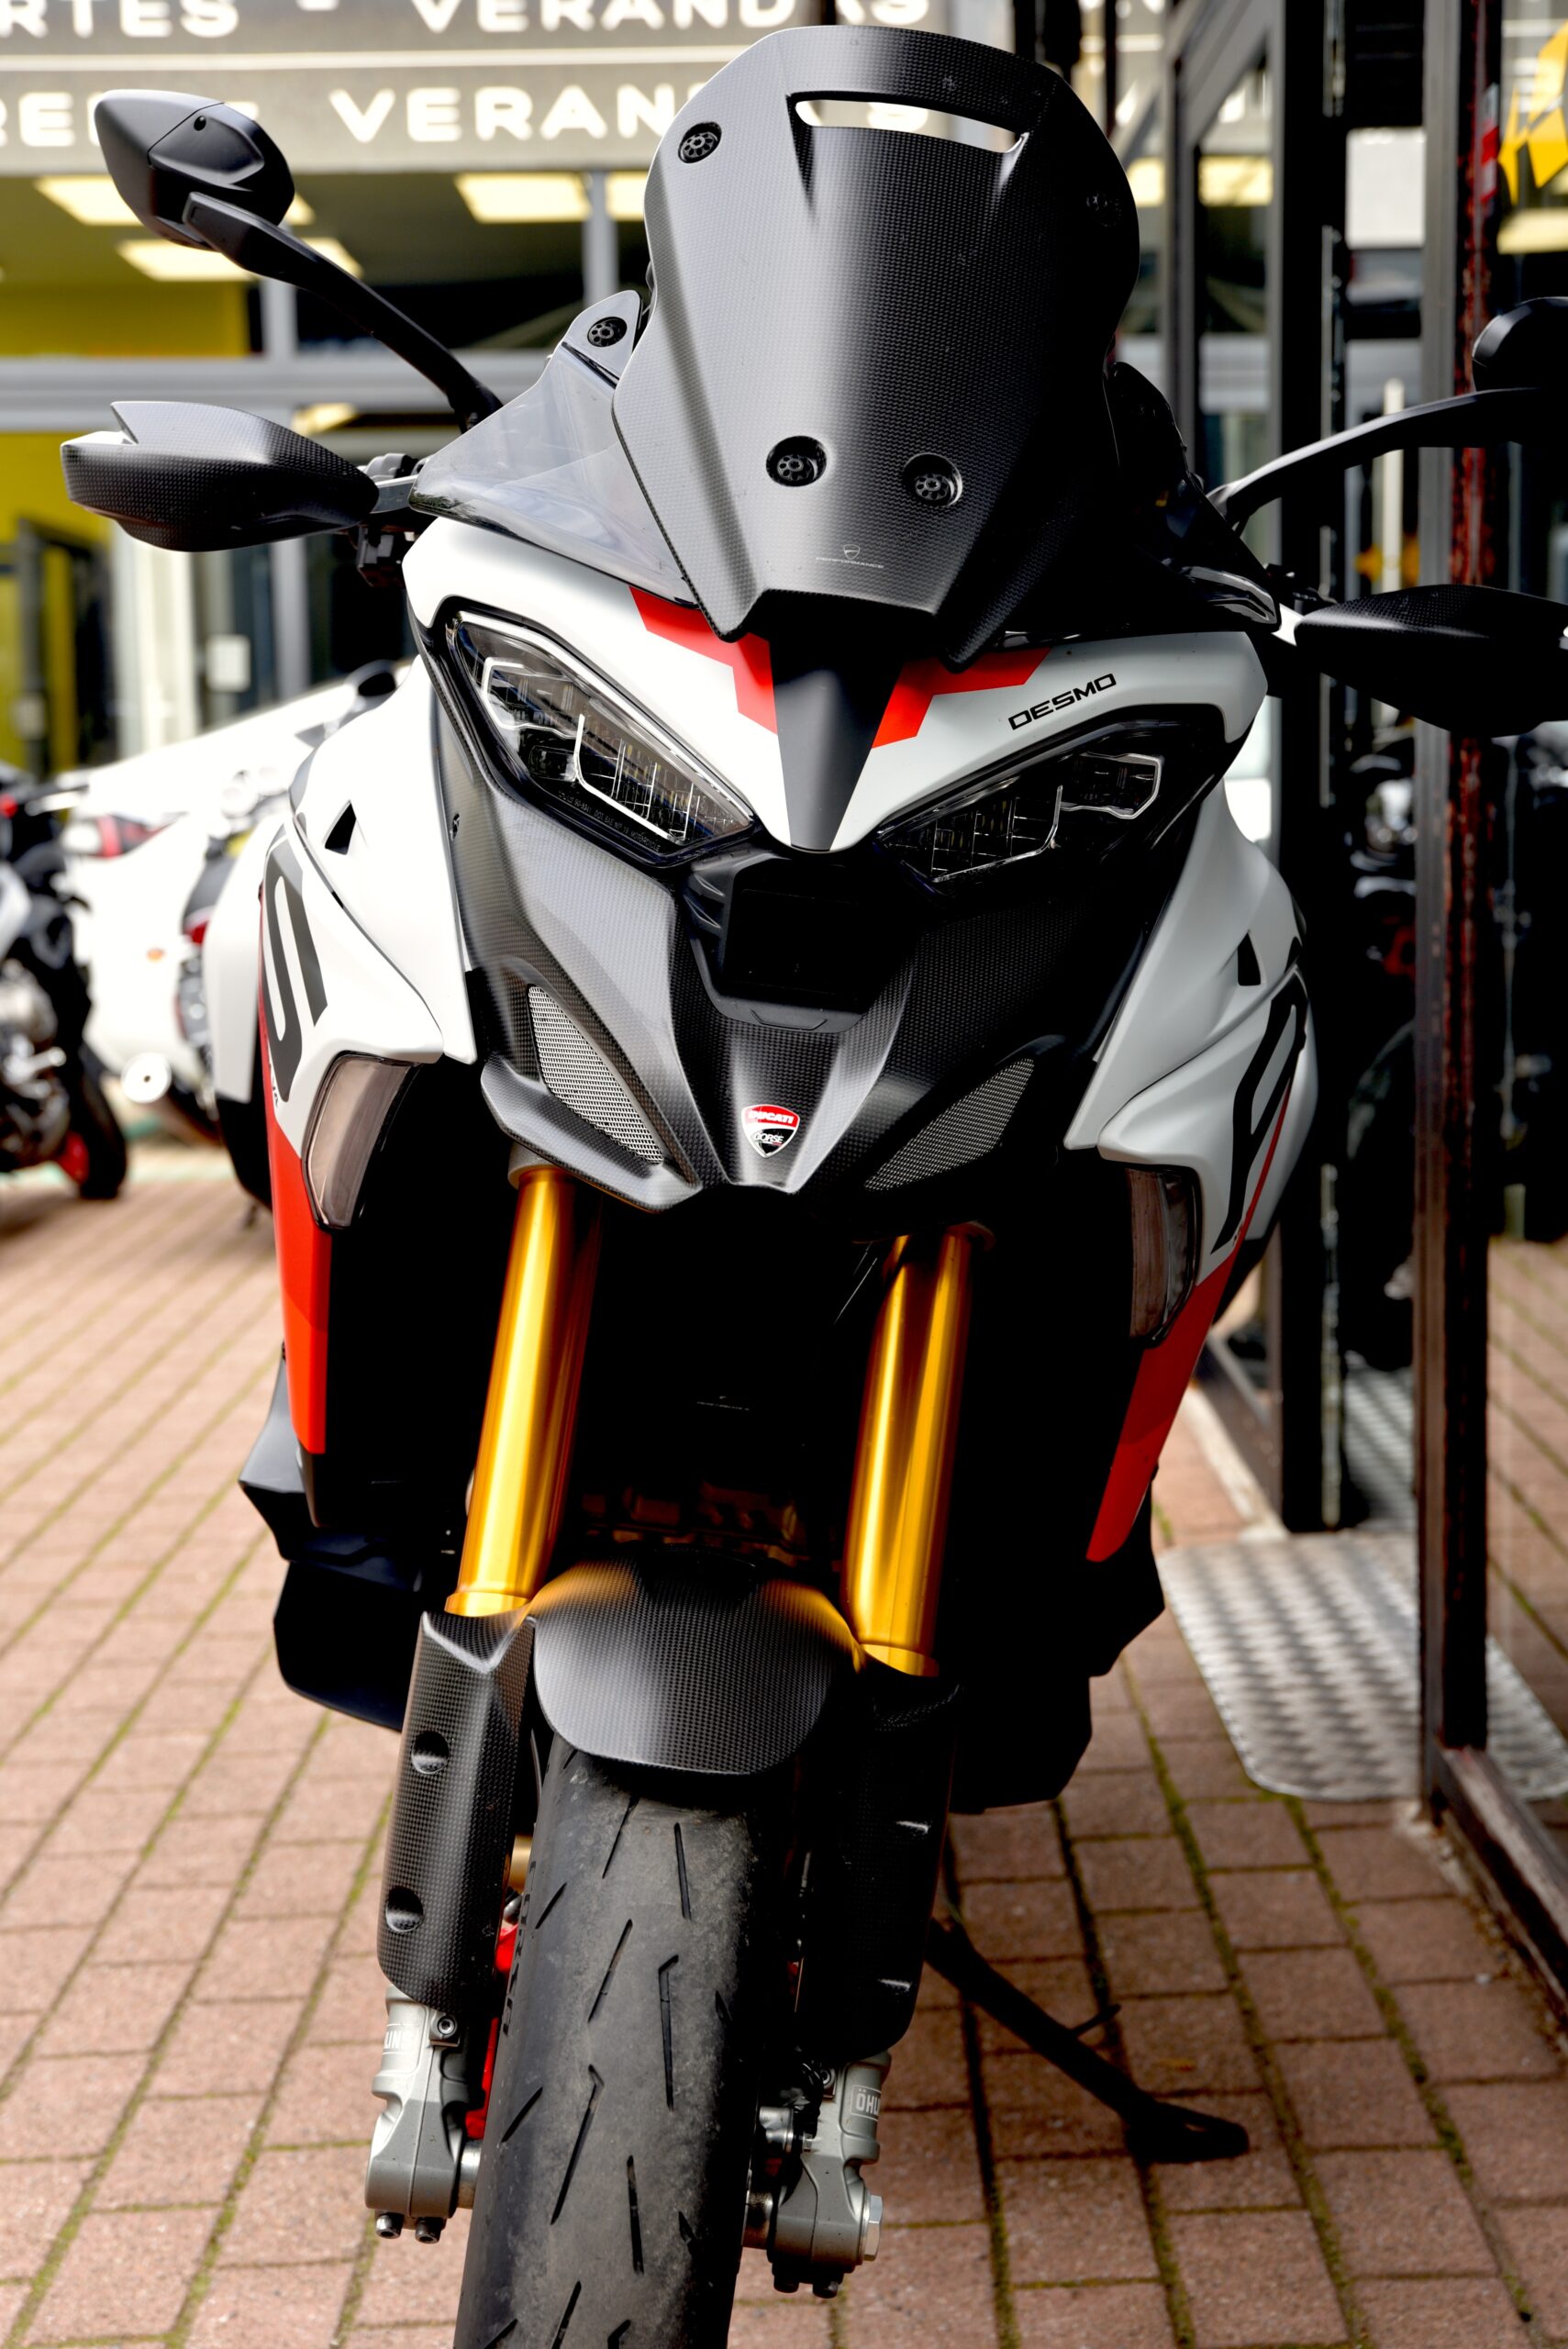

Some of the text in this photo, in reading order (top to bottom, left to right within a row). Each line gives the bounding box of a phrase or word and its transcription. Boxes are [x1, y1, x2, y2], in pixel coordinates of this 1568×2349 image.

[1007, 673, 1117, 730] DESMO
[748, 1109, 795, 1124] DUCATI
[754, 1132, 784, 1142] CORSE
